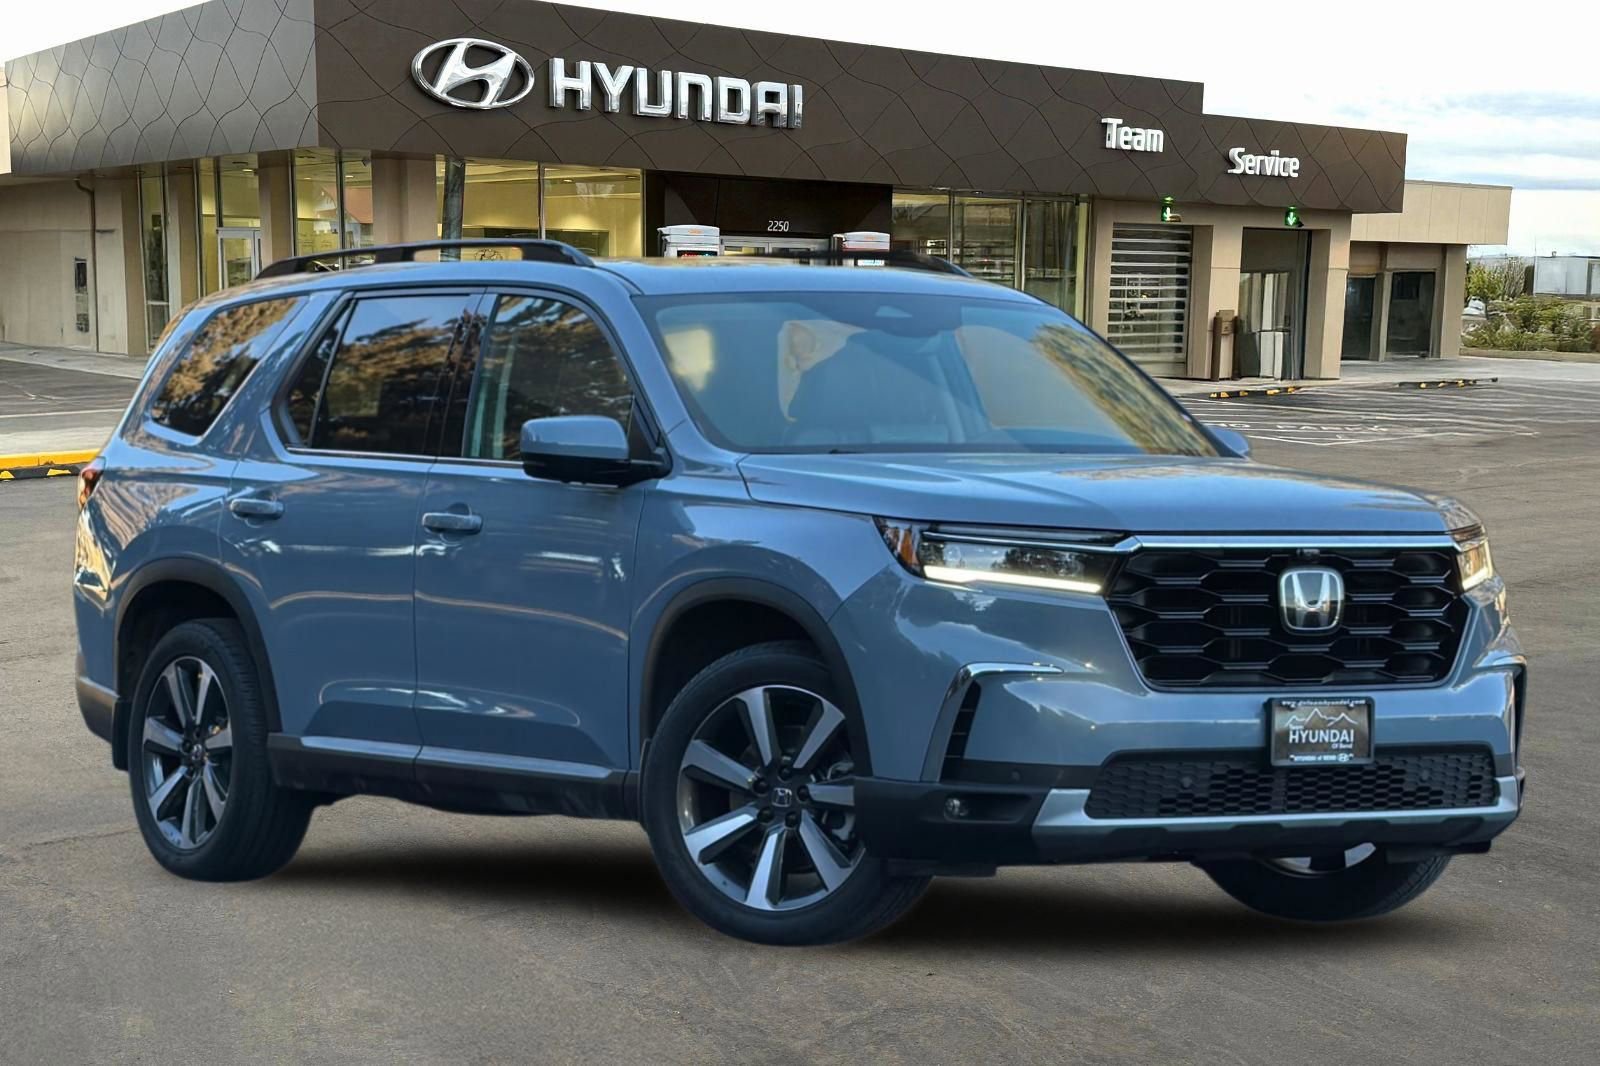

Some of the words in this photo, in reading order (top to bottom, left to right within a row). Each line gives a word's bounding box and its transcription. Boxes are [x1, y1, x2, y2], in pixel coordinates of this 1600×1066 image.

[548, 57, 803, 128] HYUNDAI
[1101, 117, 1164, 152] Team
[1227, 147, 1300, 177] Service
[767, 220, 790, 232] 2250
[1289, 729, 1354, 743] HYUNDAI
